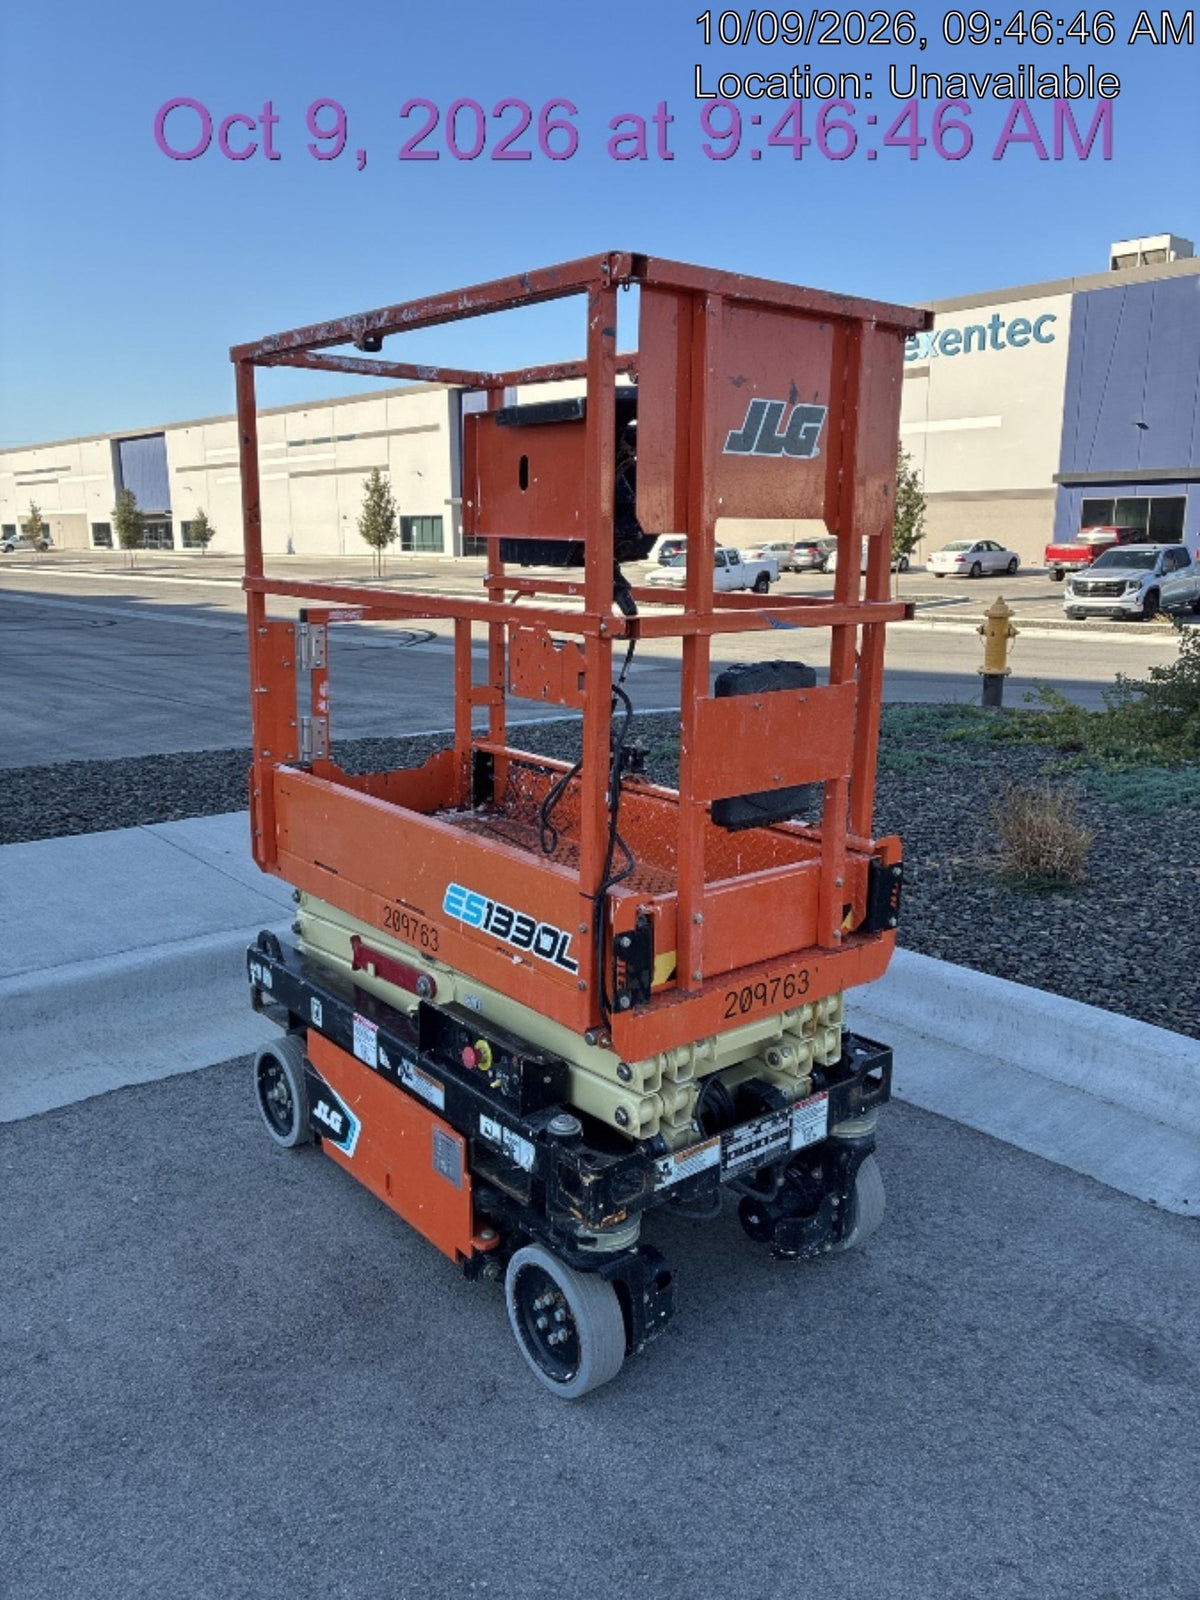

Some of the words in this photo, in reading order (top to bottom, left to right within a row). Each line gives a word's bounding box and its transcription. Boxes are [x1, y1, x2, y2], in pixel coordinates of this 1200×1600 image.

[722, 398, 828, 459] JLG
[383, 906, 440, 952] 209763
[442, 882, 579, 976] ES1330L
[724, 969, 809, 1019] 209763
[313, 1100, 343, 1135] JLG
